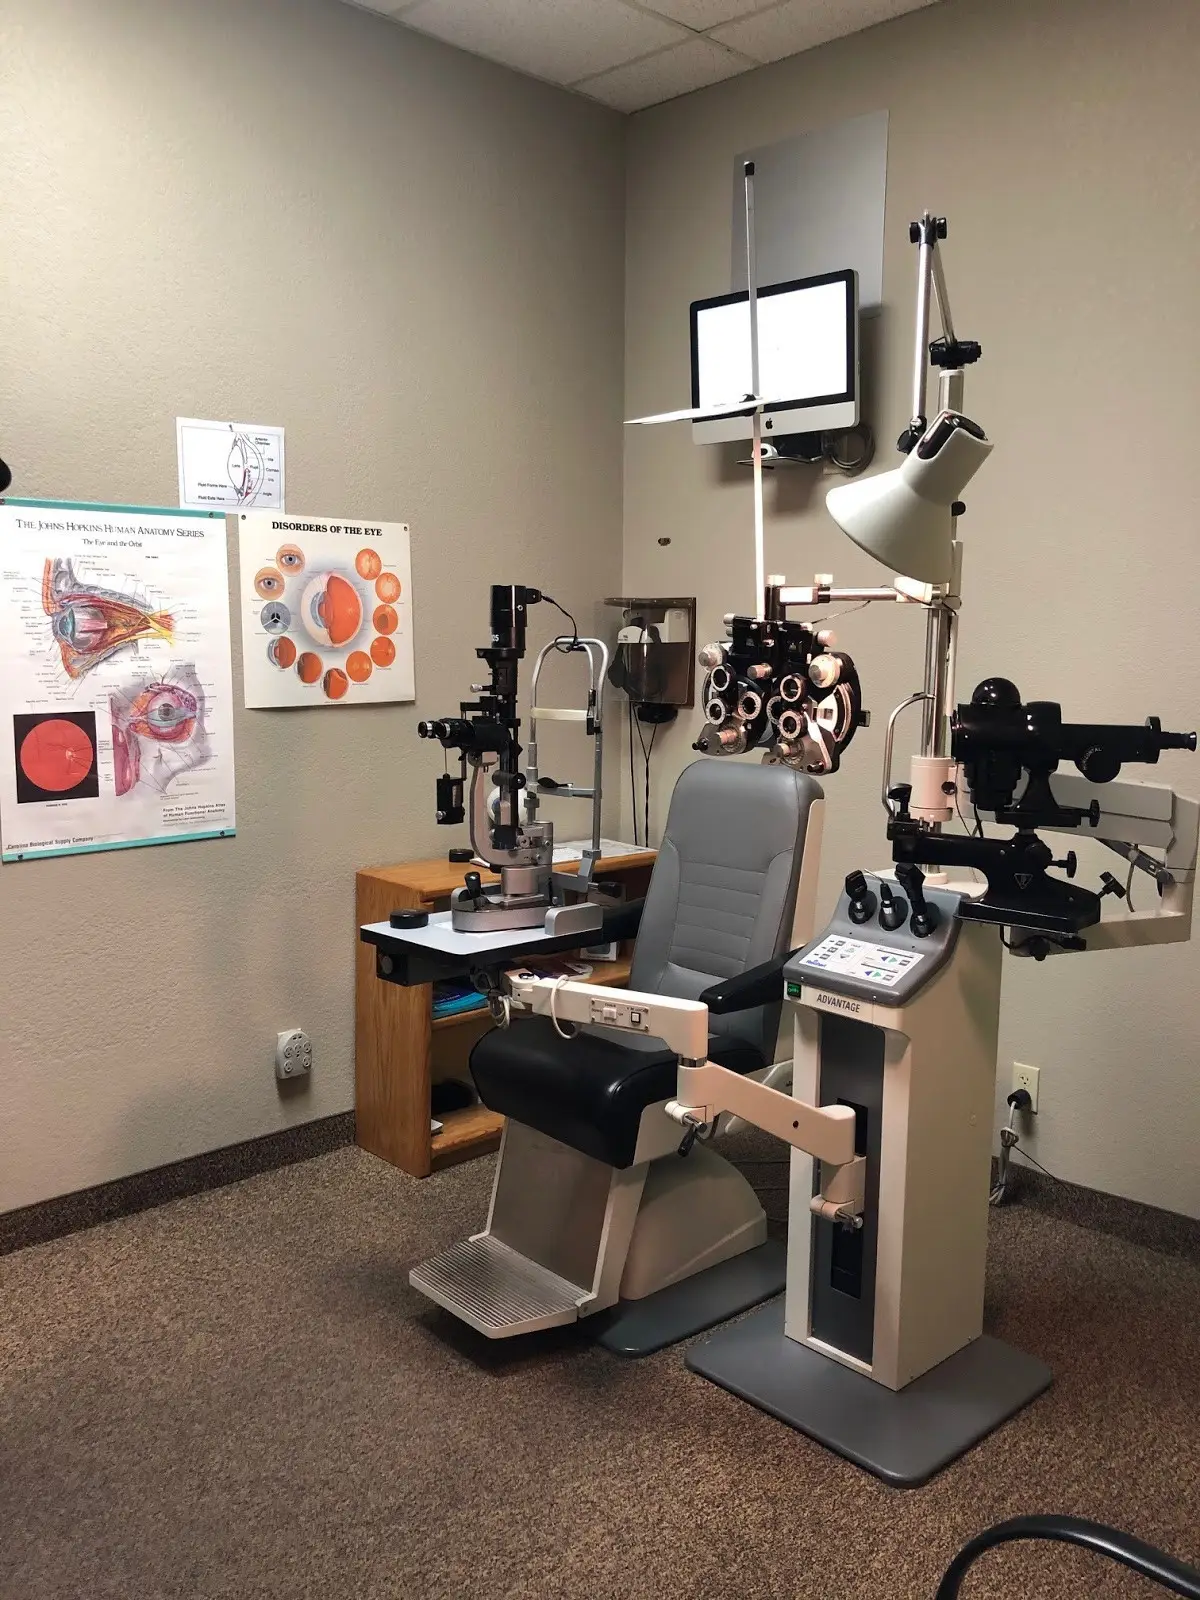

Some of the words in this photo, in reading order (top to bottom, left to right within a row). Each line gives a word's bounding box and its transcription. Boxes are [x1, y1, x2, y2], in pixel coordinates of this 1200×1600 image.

[15, 518, 36, 529] THE
[38, 520, 64, 532] JOHNS
[66, 521, 103, 533] HOPKINS
[104, 524, 136, 534] HUMAN
[137, 526, 175, 537] ANATOMY
[176, 528, 205, 538] SERIES
[272, 521, 328, 533] DISORDERS
[329, 525, 343, 534] OF
[343, 526, 363, 535] THE
[364, 528, 383, 536] EYE
[82, 538, 94, 546] The
[95, 539, 106, 547] Eye
[29, 839, 54, 848] Biological
[54, 837, 71, 846] Supply
[72, 836, 94, 844] Company
[816, 993, 861, 1013] ADVANTAGE
